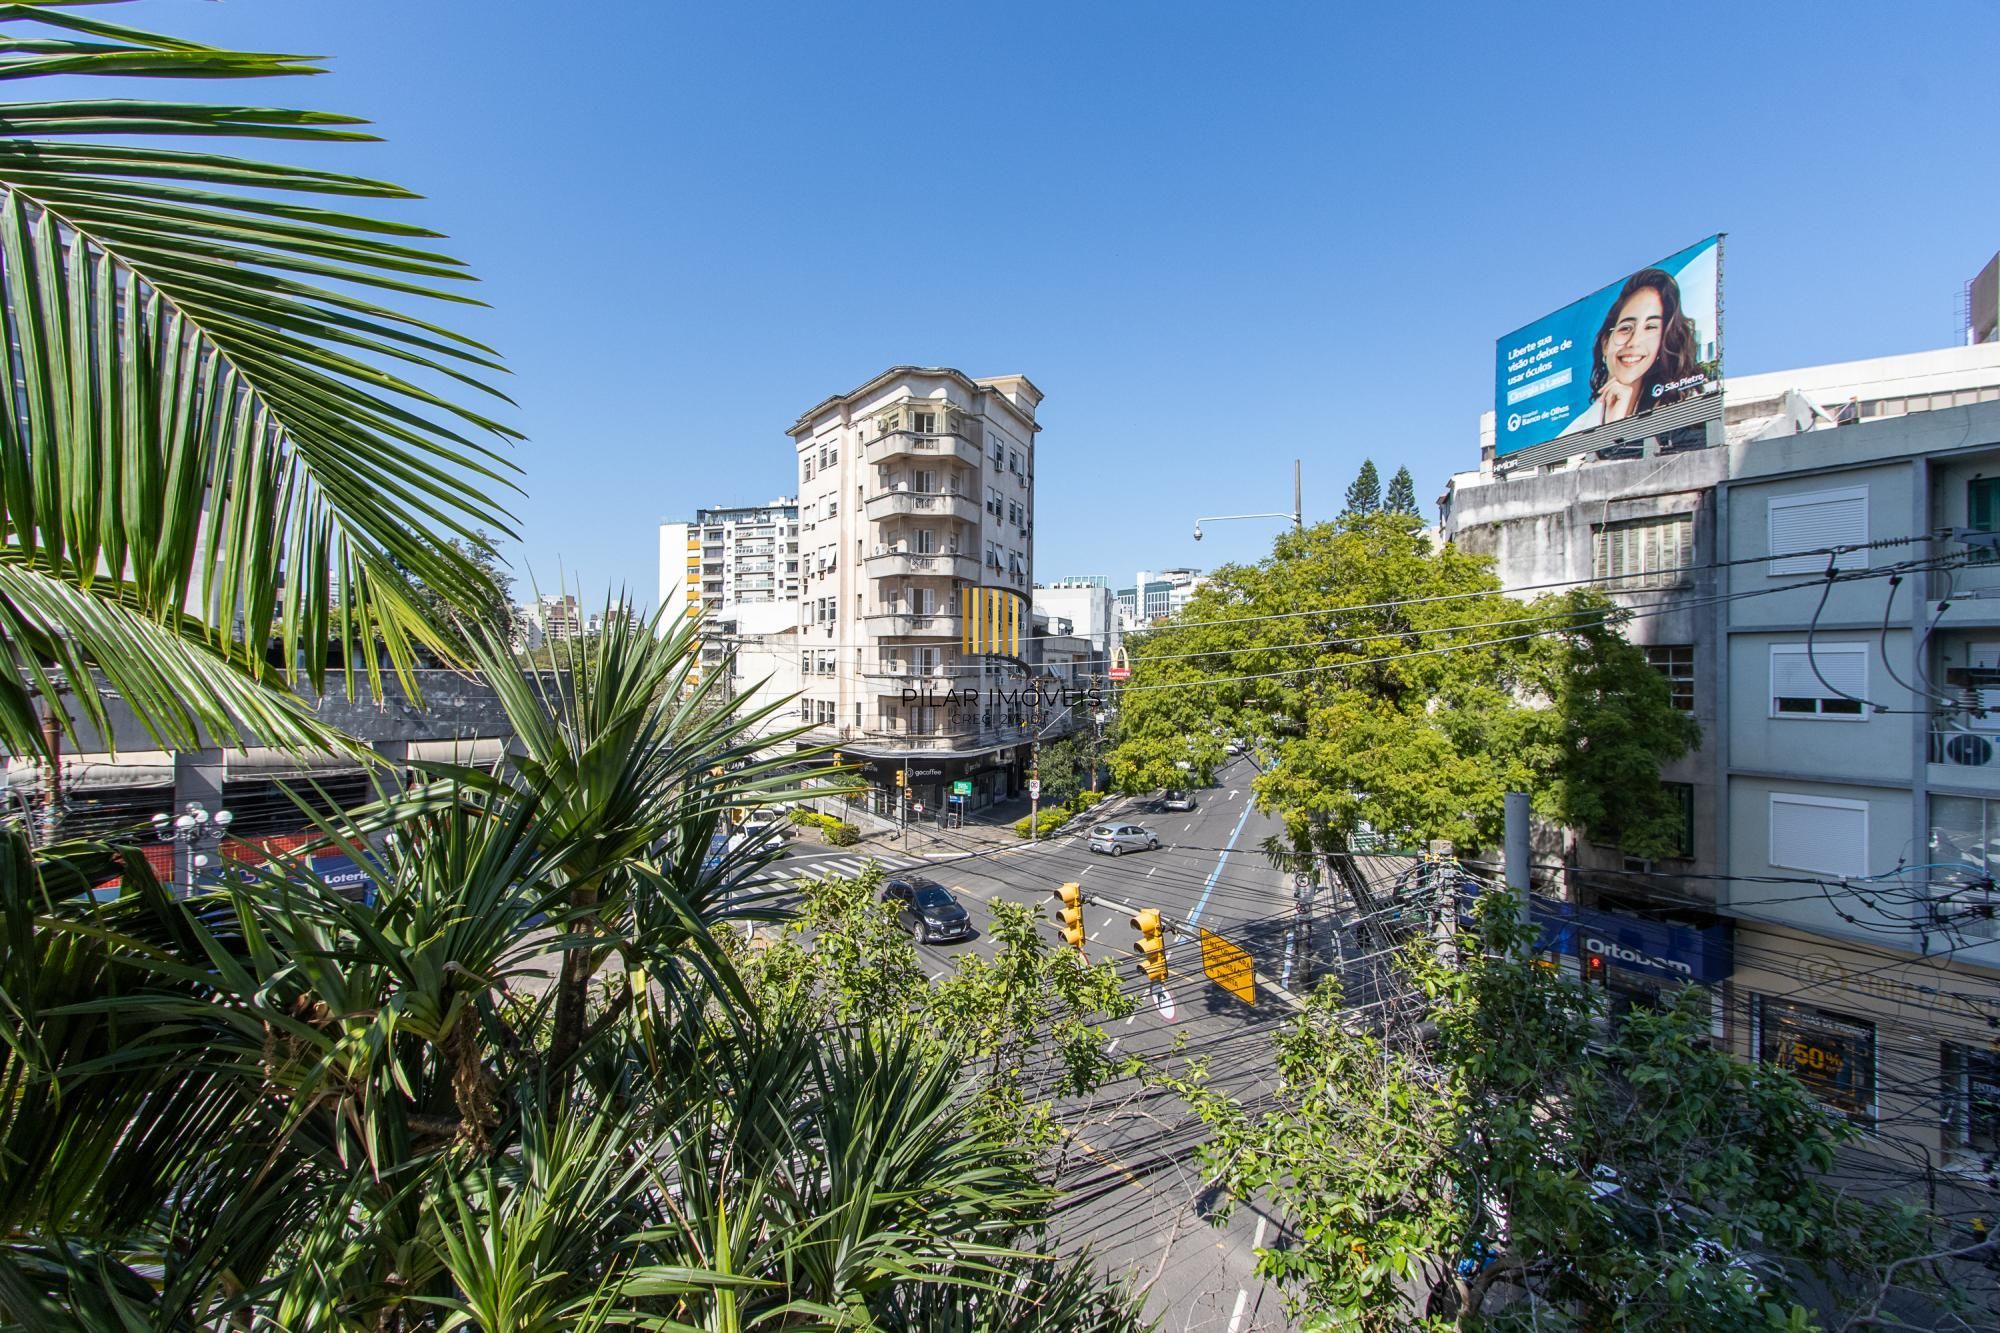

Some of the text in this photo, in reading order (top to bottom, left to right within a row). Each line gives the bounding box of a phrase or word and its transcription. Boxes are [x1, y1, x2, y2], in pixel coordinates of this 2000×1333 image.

[1508, 335, 1553, 361] Liberte sua
[1508, 339, 1573, 372] visão e deixe de
[1508, 361, 1553, 385] usar óculos
[1664, 381, 1680, 391] São
[1680, 373, 1705, 387] Pietro
[914, 768, 942, 777] gocoffee
